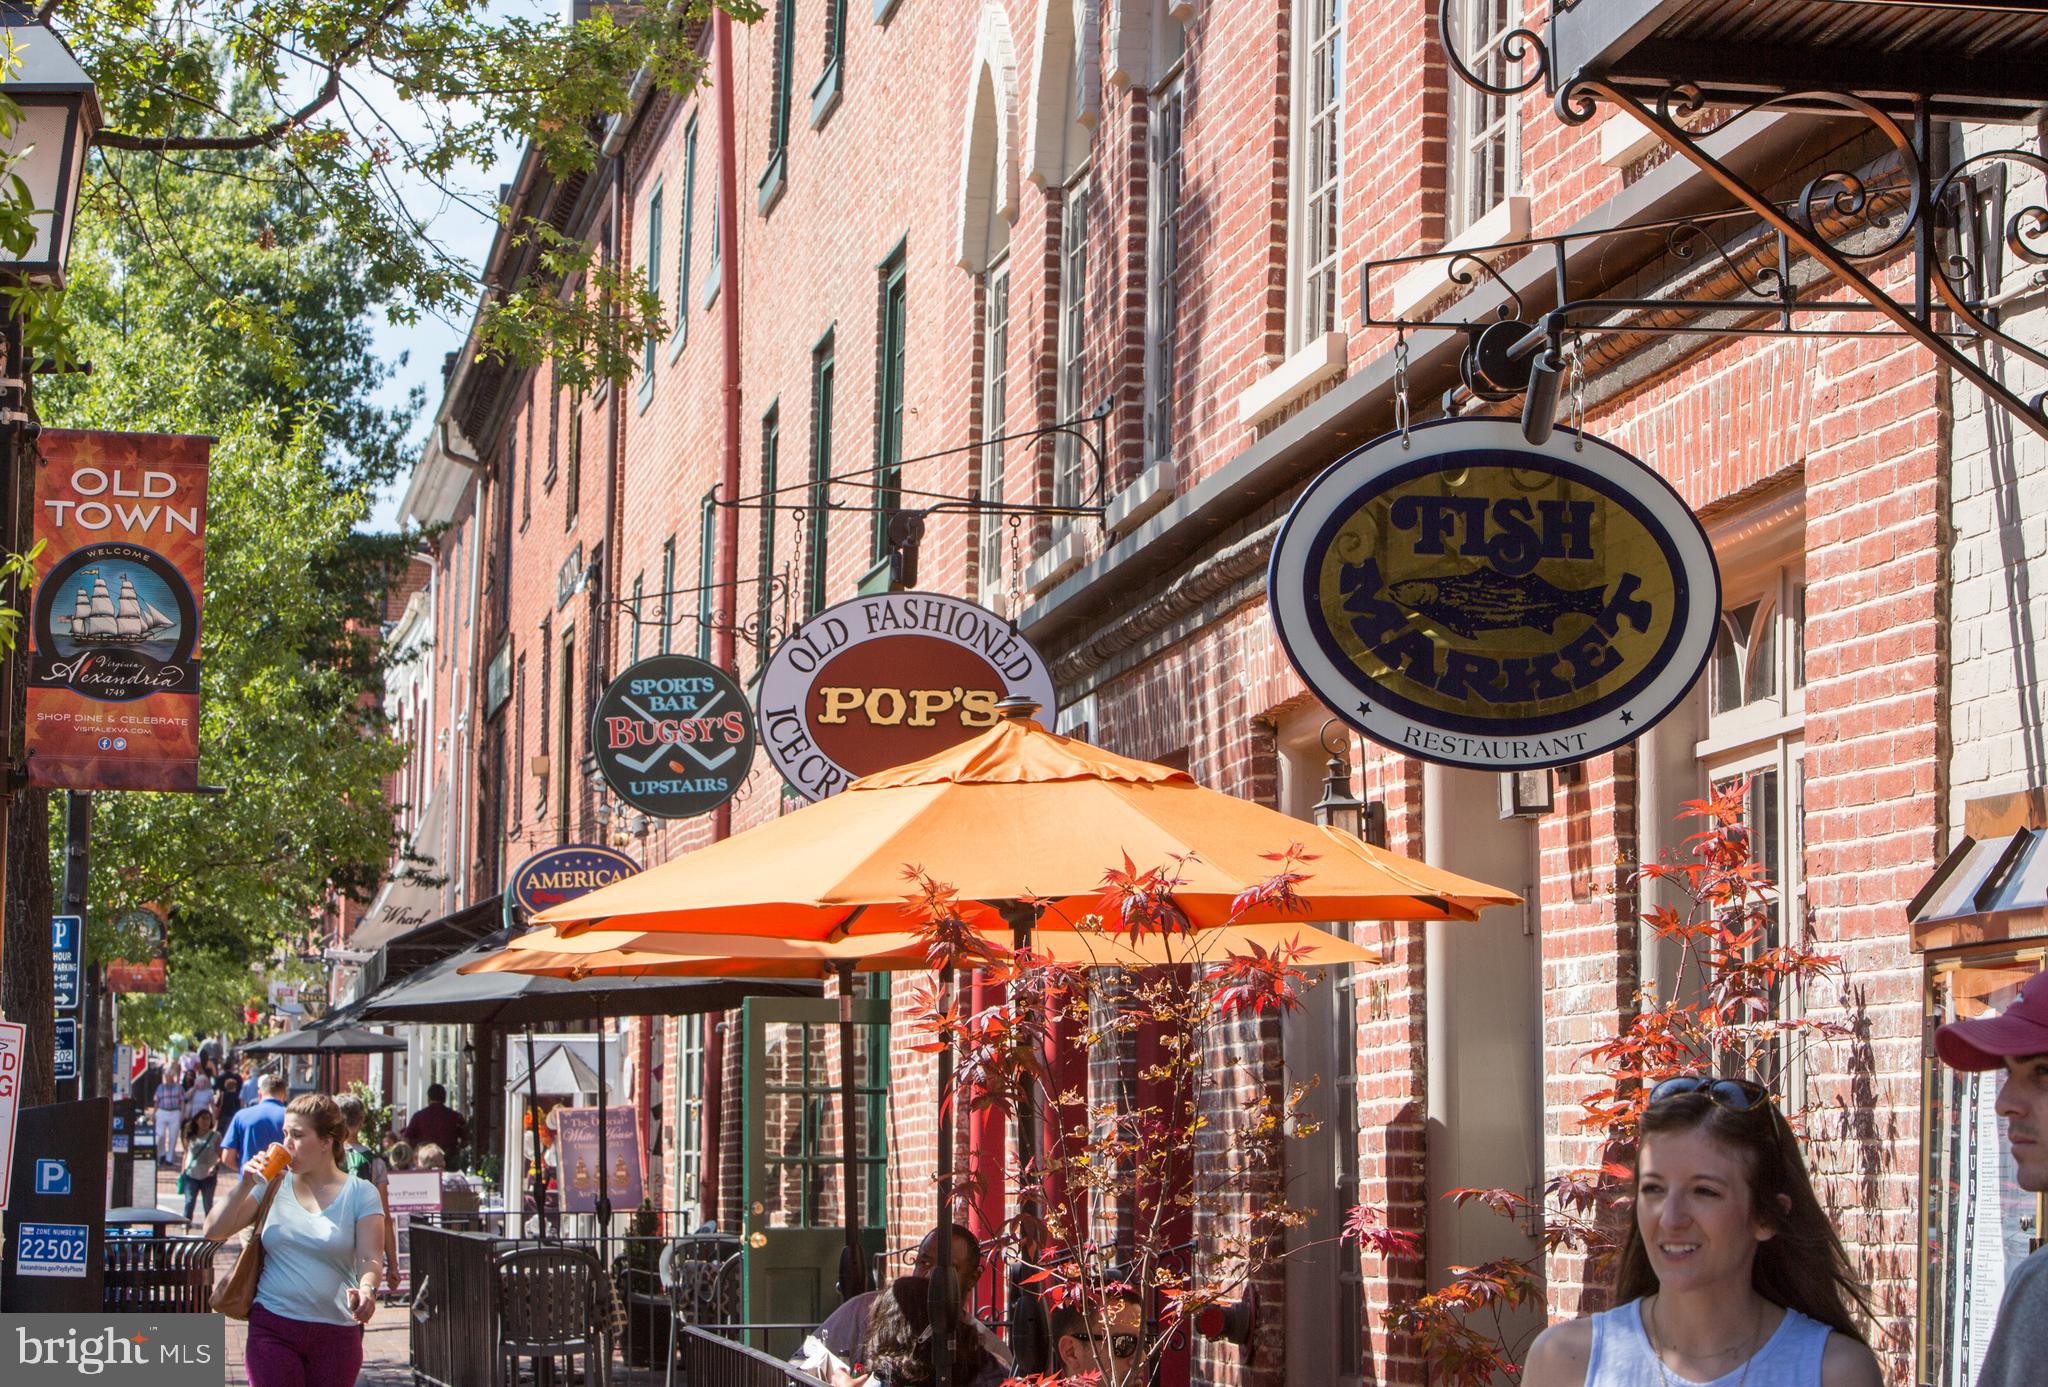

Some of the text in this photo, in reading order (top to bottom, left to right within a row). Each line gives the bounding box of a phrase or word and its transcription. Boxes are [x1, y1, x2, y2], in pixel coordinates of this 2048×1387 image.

[70, 467, 178, 498] OLD
[44, 499, 198, 535] TOWN
[1390, 494, 1595, 576] FISH
[86, 548, 151, 562] WELCOME
[787, 599, 1034, 682] OLD FASHIONED
[1339, 557, 1652, 703] MARKET
[41, 651, 185, 687] Alexandria
[95, 655, 140, 673] Virginia
[105, 688, 125, 697] 1749
[630, 676, 715, 696] SPORTS
[648, 694, 697, 714] BAR
[818, 686, 1001, 727] POP'S
[74, 714, 104, 723] DINE
[107, 715, 115, 724] &
[120, 715, 189, 727] CELEBRATE
[606, 710, 745, 750] BUGSY'S
[1403, 726, 1588, 760] RESTAURANT
[629, 776, 728, 796] UPSTAIRS
[526, 867, 631, 890] AMERICA!
[382, 905, 431, 926] Wharf
[53, 951, 71, 961] HOUR
[53, 962, 77, 972] PARKING
[54, 1051, 71, 1062] 502
[591, 1116, 625, 1126] Oicial
[42, 1162, 65, 1190] P
[1966, 1071, 1979, 1265] STAURANT
[36, 1228, 76, 1237] ZONE NUMBER
[21, 1238, 84, 1261] 22502
[1964, 1275, 1971, 1291] &
[1962, 1302, 1970, 1364] RAW
